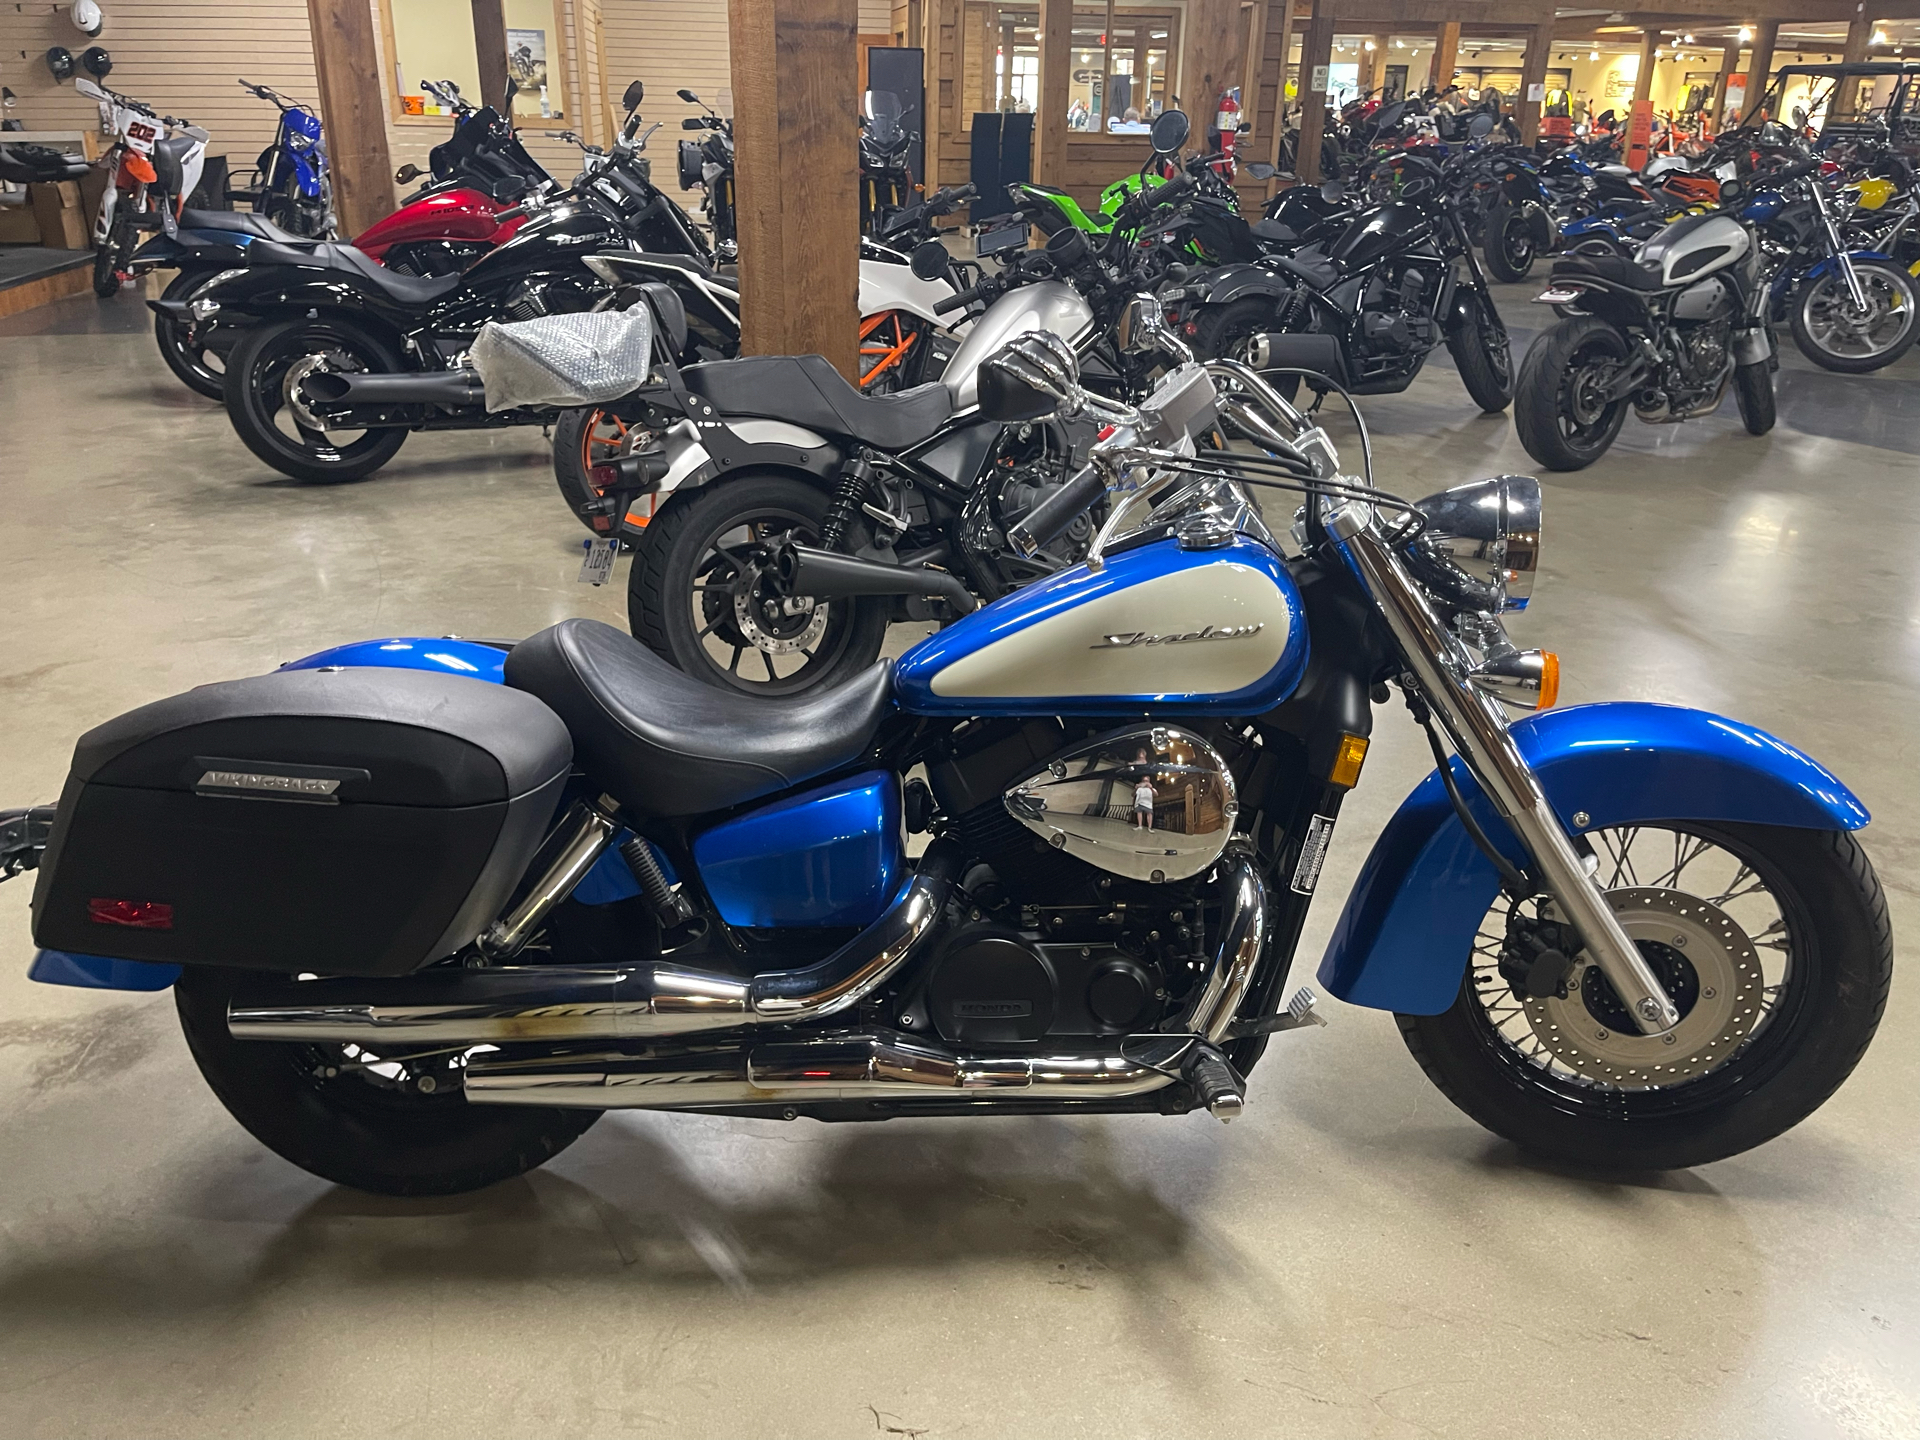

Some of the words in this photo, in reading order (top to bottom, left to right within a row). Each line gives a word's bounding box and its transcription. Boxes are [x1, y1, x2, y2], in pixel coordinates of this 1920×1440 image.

[1316, 68, 1327, 76] NO
[126, 121, 157, 144] 202
[1089, 622, 1265, 649] Shadow
[960, 1003, 1024, 1014] HONDA
